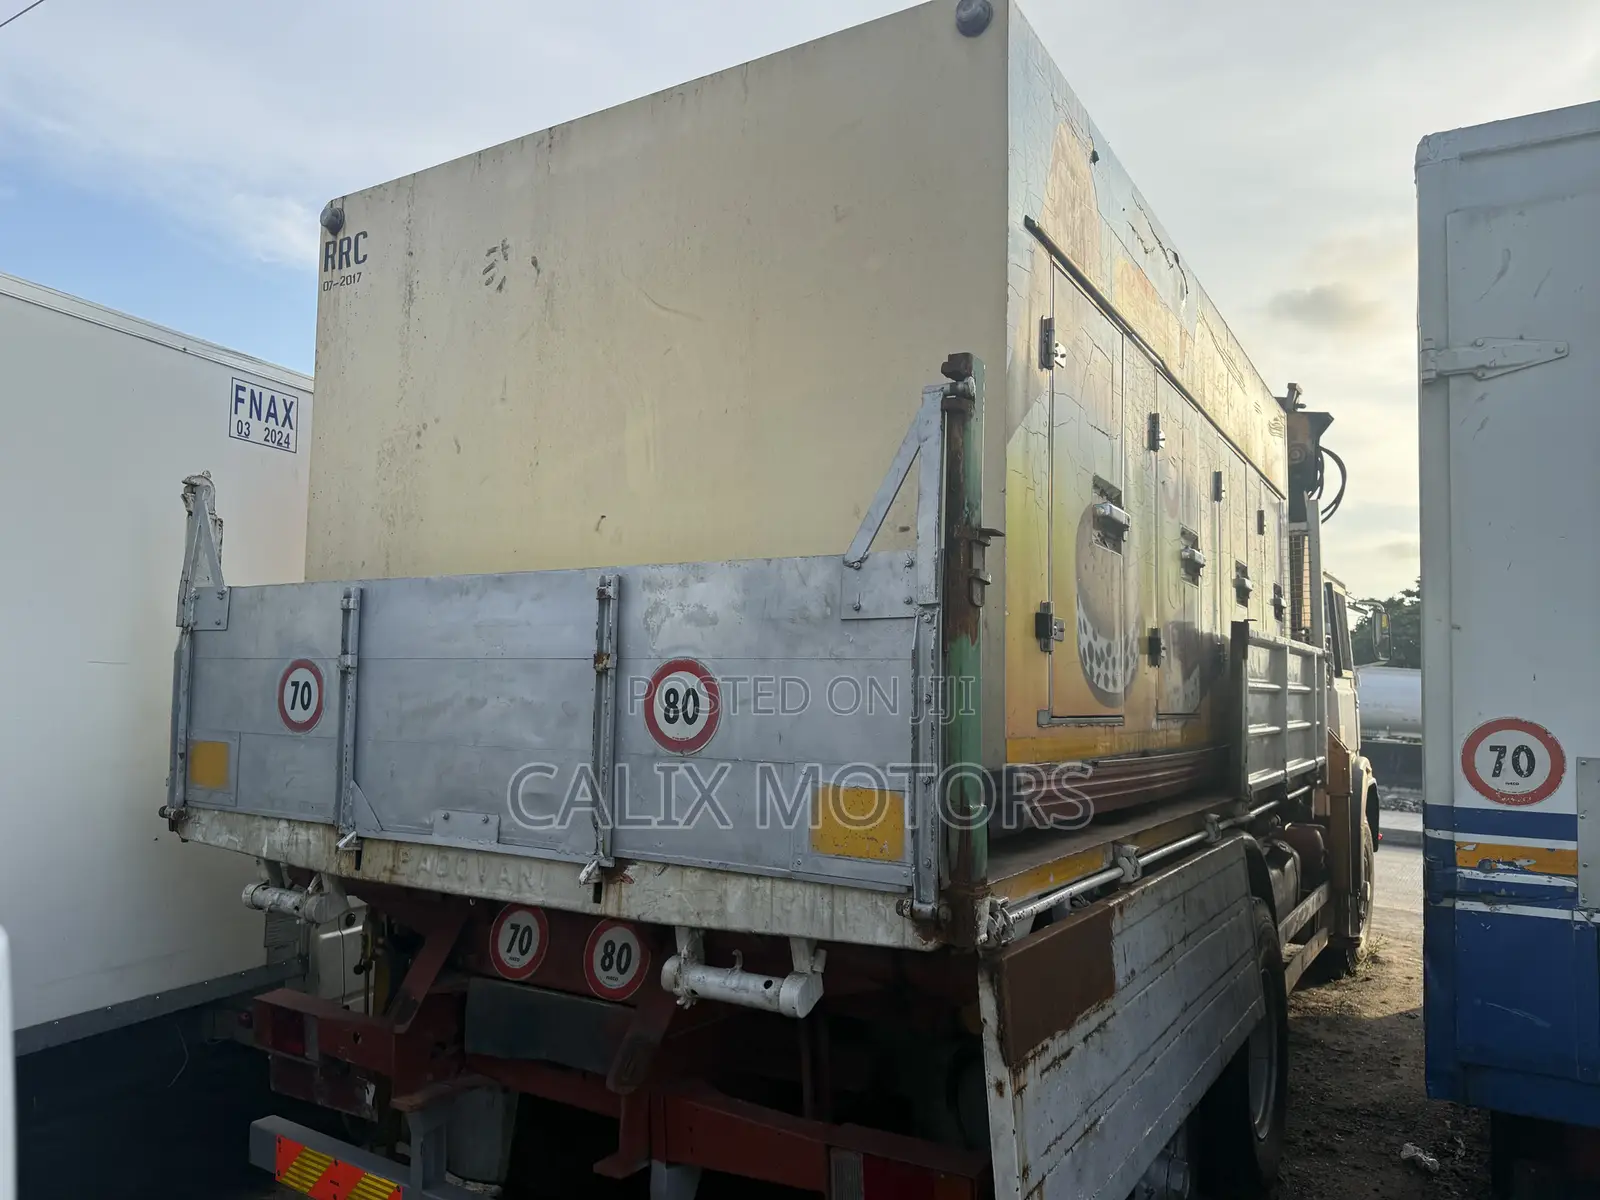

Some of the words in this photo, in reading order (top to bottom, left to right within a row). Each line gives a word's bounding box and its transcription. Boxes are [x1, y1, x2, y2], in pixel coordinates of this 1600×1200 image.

[323, 230, 368, 272] RRC
[322, 271, 362, 292] 07-2017
[234, 384, 294, 430] FNAX
[236, 419, 251, 438] 03
[263, 426, 291, 449] 2024
[290, 680, 312, 711] 70
[663, 688, 700, 725] 80
[1489, 744, 1536, 778] 70
[506, 923, 533, 956] 70
[601, 939, 632, 975] 80
